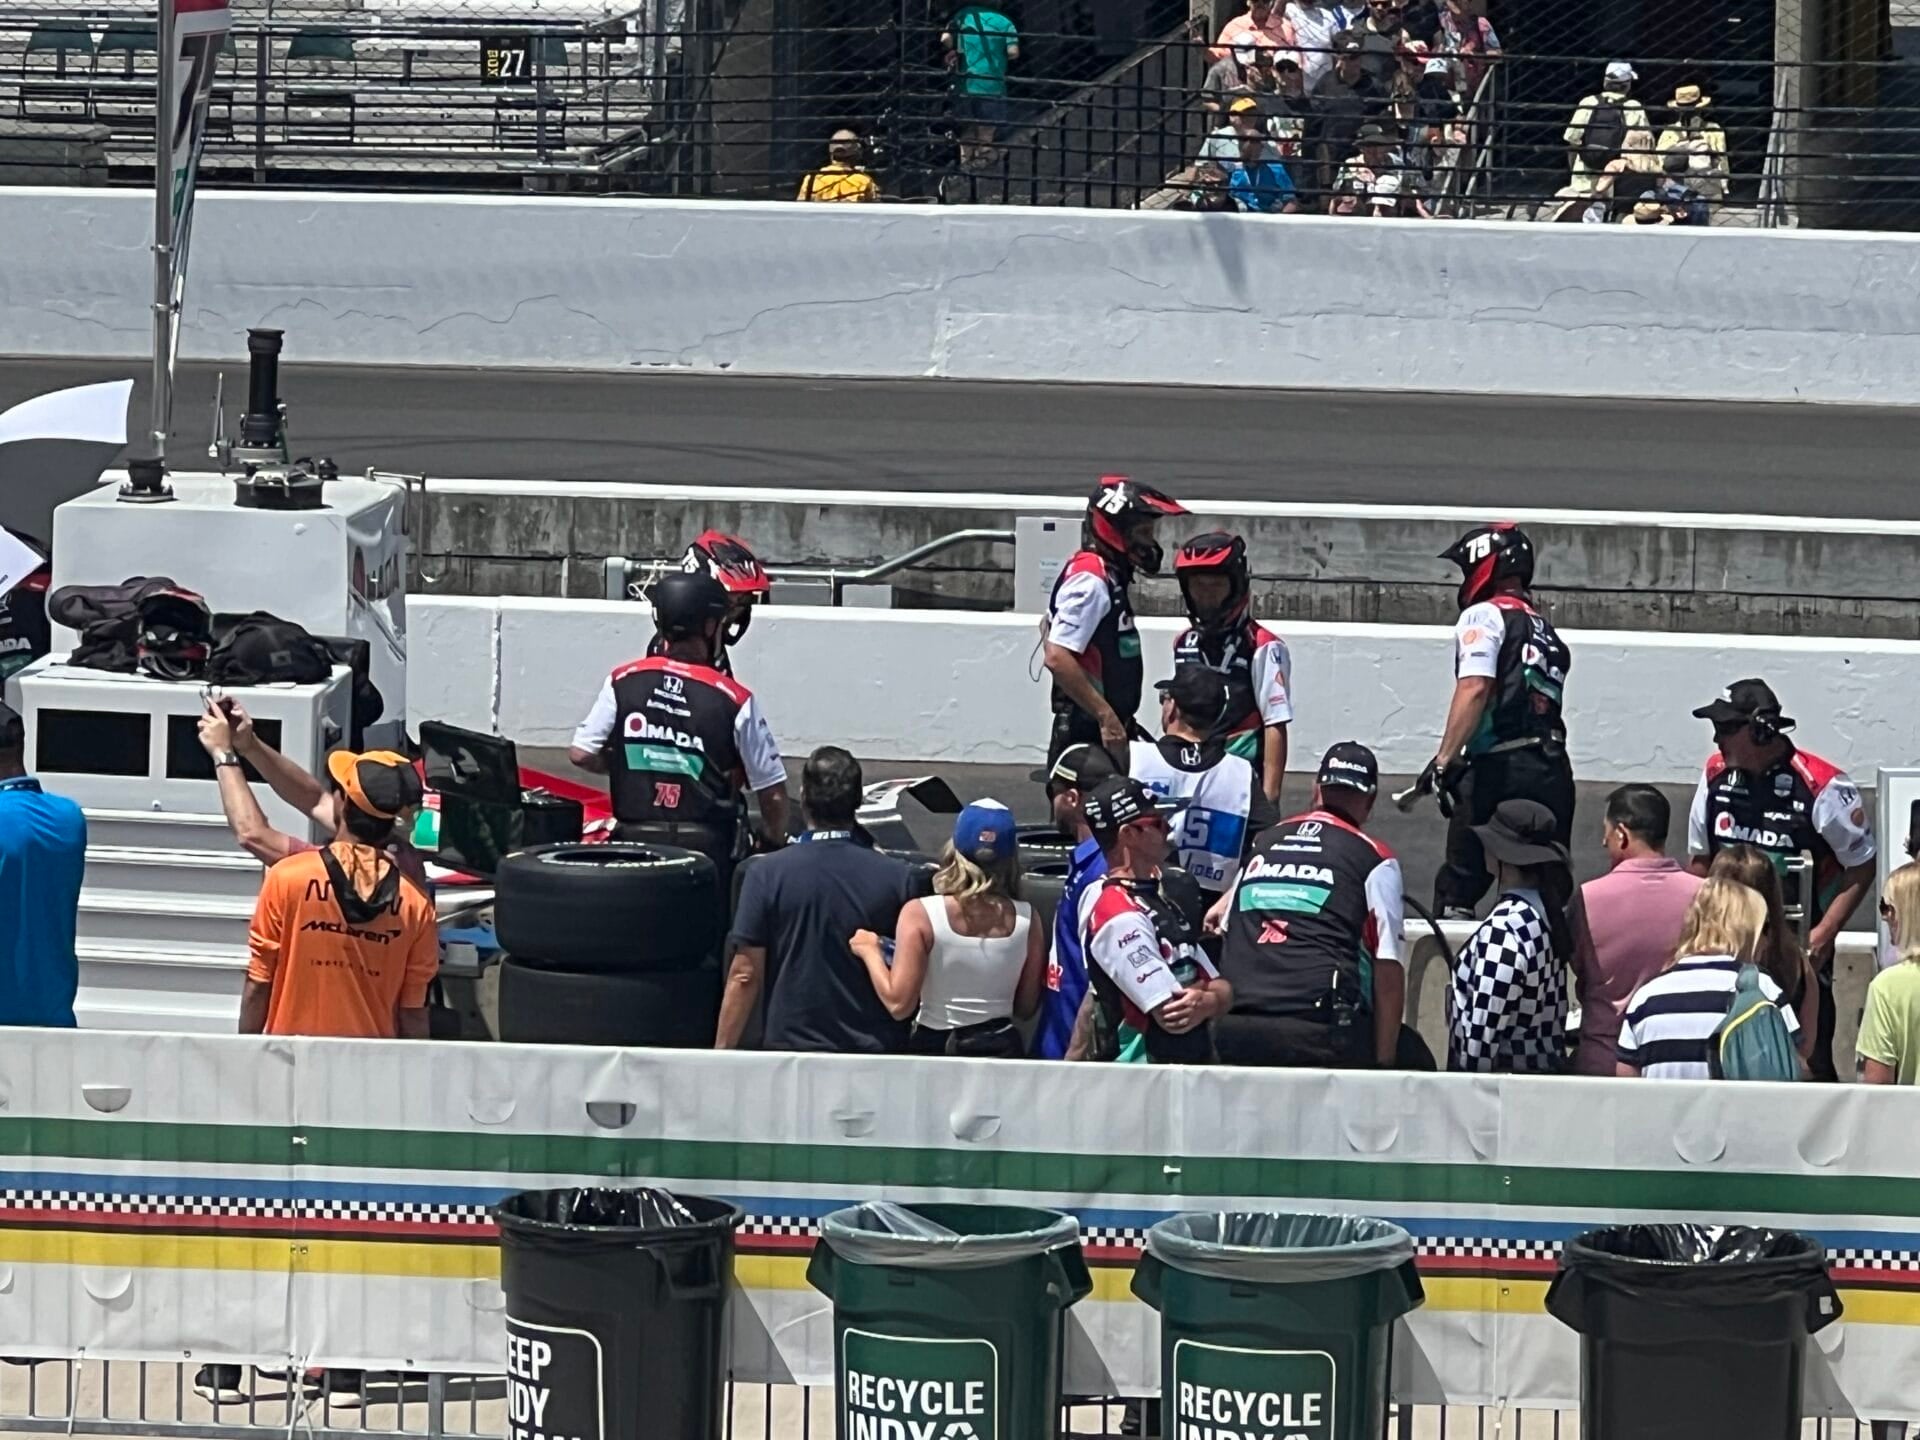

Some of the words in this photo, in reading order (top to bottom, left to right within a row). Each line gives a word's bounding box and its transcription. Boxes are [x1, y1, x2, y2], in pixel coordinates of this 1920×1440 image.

[487, 49, 499, 77] BOX
[500, 49, 525, 77] 27
[1466, 533, 1491, 563] 75
[653, 781, 681, 808] 75
[301, 920, 390, 945] McLaren
[507, 1332, 551, 1381] EEP
[508, 1379, 550, 1428] DY
[848, 1370, 984, 1416] RECYCLE
[1180, 1381, 1322, 1427] RECYCLE
